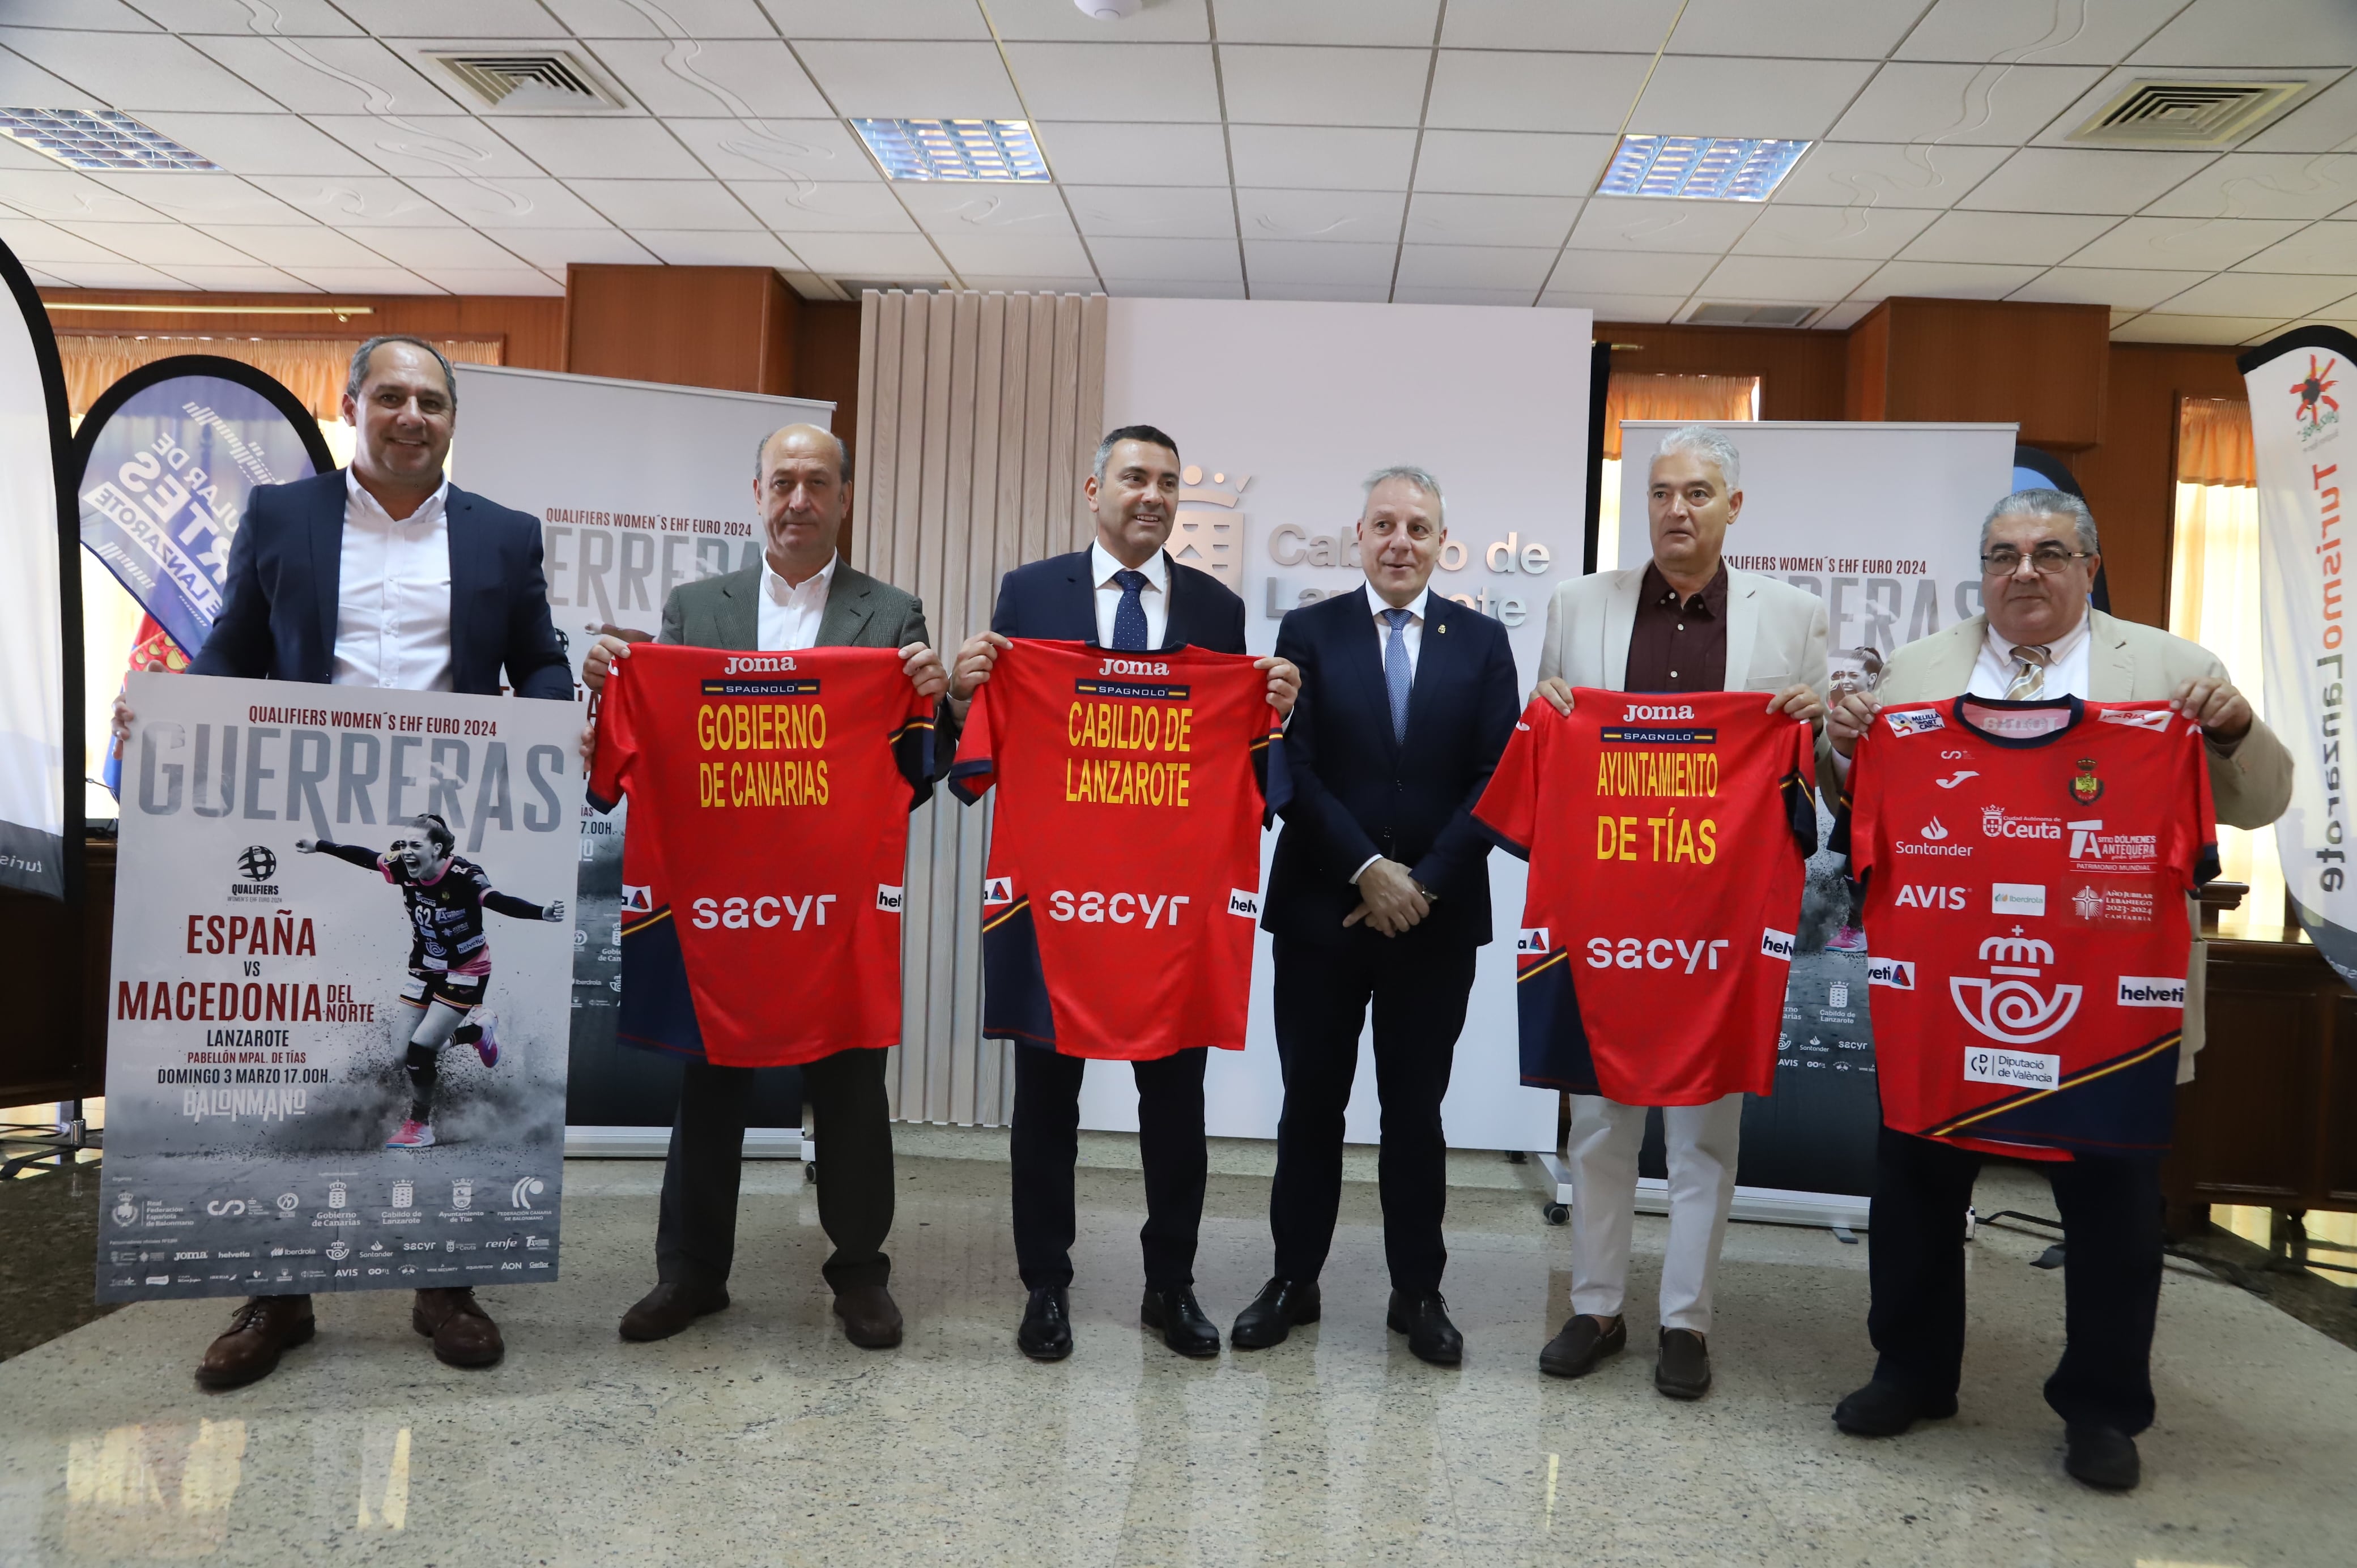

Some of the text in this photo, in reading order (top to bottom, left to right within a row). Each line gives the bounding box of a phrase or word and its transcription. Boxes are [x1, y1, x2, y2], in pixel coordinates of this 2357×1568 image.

[546, 508, 610, 526] QUALIFIERS
[670, 517, 690, 532] EHF
[693, 519, 720, 534] EURO
[725, 522, 752, 537] 2024
[1486, 532, 1550, 574] de
[1724, 555, 1776, 571] ALIFIERS
[1839, 559, 1859, 573] EHF
[1862, 560, 1892, 574] EURO
[1896, 560, 1926, 574] 2024
[249, 705, 327, 727] QUALIFIERS
[399, 718, 423, 732] EHF
[426, 719, 460, 735] EURO
[463, 720, 497, 737] 2024
[1068, 701, 1193, 752] CABILDO DE
[1912, 713, 1941, 722] MELILLA
[697, 704, 827, 751] GOBIERNO
[700, 760, 829, 808] DE CANARIAS
[1066, 758, 1190, 807] LANZAROTE
[1597, 752, 1718, 798] AYUNTAMIENTO
[138, 721, 565, 854] GUERRERAS
[1597, 807, 1717, 865] DE TÍAS
[2002, 821, 2061, 840] Ceuta
[1895, 841, 1973, 857] Santander
[2102, 843, 2155, 856] ANTEQUERA
[232, 884, 279, 896] QUALIFIERS
[1895, 885, 1966, 910] AVIS
[2009, 894, 2043, 904] Iberdrola
[1049, 890, 1190, 929] sacyr
[2105, 897, 2152, 906] LEBANIEGO
[2105, 905, 2152, 915] 2023-2024
[692, 894, 837, 931] sacyr
[187, 909, 316, 956] ESPAÑA
[1586, 937, 1729, 974] sacyr
[244, 961, 260, 977] VS
[117, 981, 322, 1021] MACEDONIA
[327, 985, 354, 1004] DEL
[325, 1004, 375, 1022] NORTE
[207, 1029, 290, 1047] LANZAROTE
[1839, 1041, 1867, 1050] sacyr
[188, 1050, 306, 1064] PABELLÓN MPAL. DE TÍAS
[1778, 1059, 1798, 1067] AVIS
[1998, 1055, 2044, 1070] Diputació
[158, 1068, 333, 1084] DOMINGO 3 MARZO 17.00H.
[1997, 1067, 2052, 1084] de València
[183, 1088, 306, 1122] BALONMANO
[323, 1218, 361, 1226] Canarias
[403, 1242, 436, 1251] sacyr
[486, 1237, 517, 1250] renfe
[218, 1250, 250, 1259] helvetia
[335, 1269, 358, 1277] AVIS
